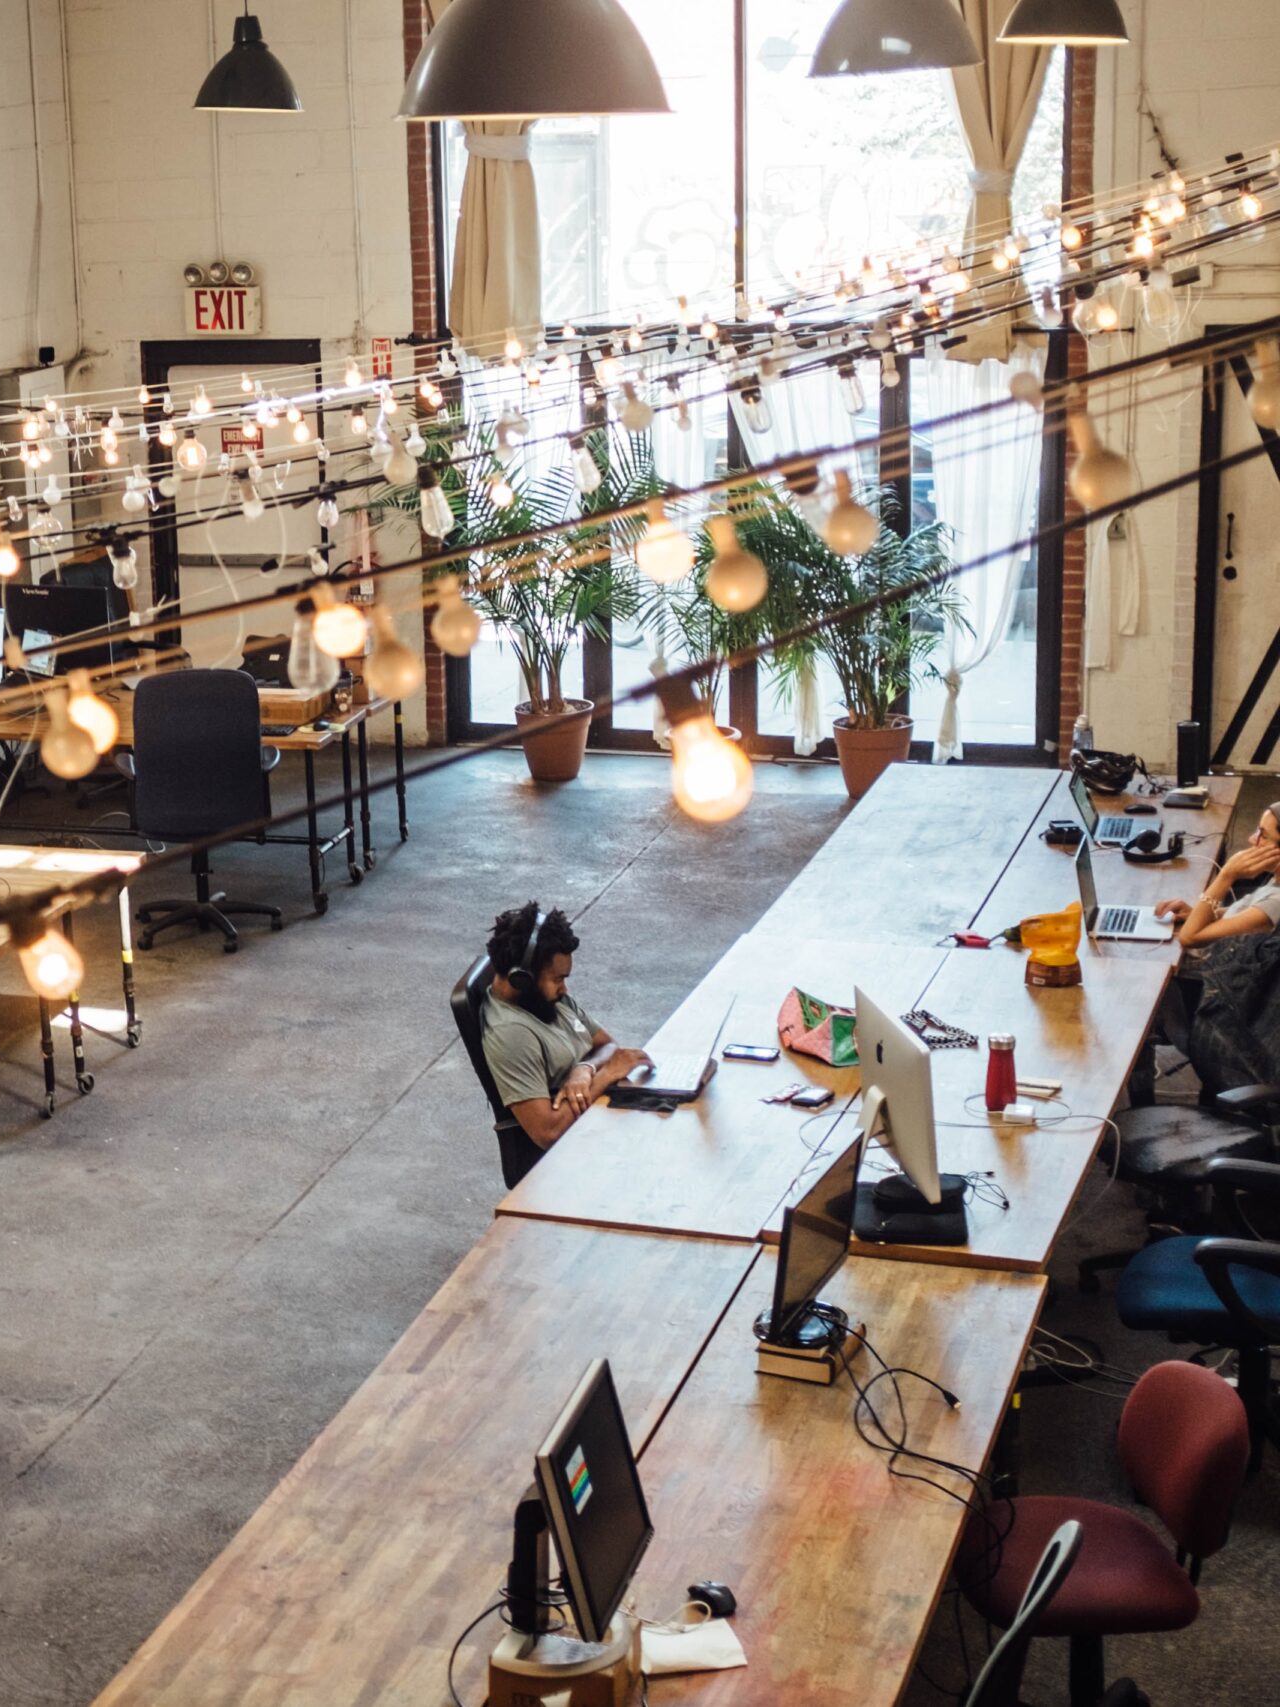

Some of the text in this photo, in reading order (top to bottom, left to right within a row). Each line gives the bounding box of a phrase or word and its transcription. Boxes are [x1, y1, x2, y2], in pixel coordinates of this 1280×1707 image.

[195, 290, 247, 330] EXIT
[375, 343, 388, 352] FIRE
[223, 430, 261, 442] EMERGCY
